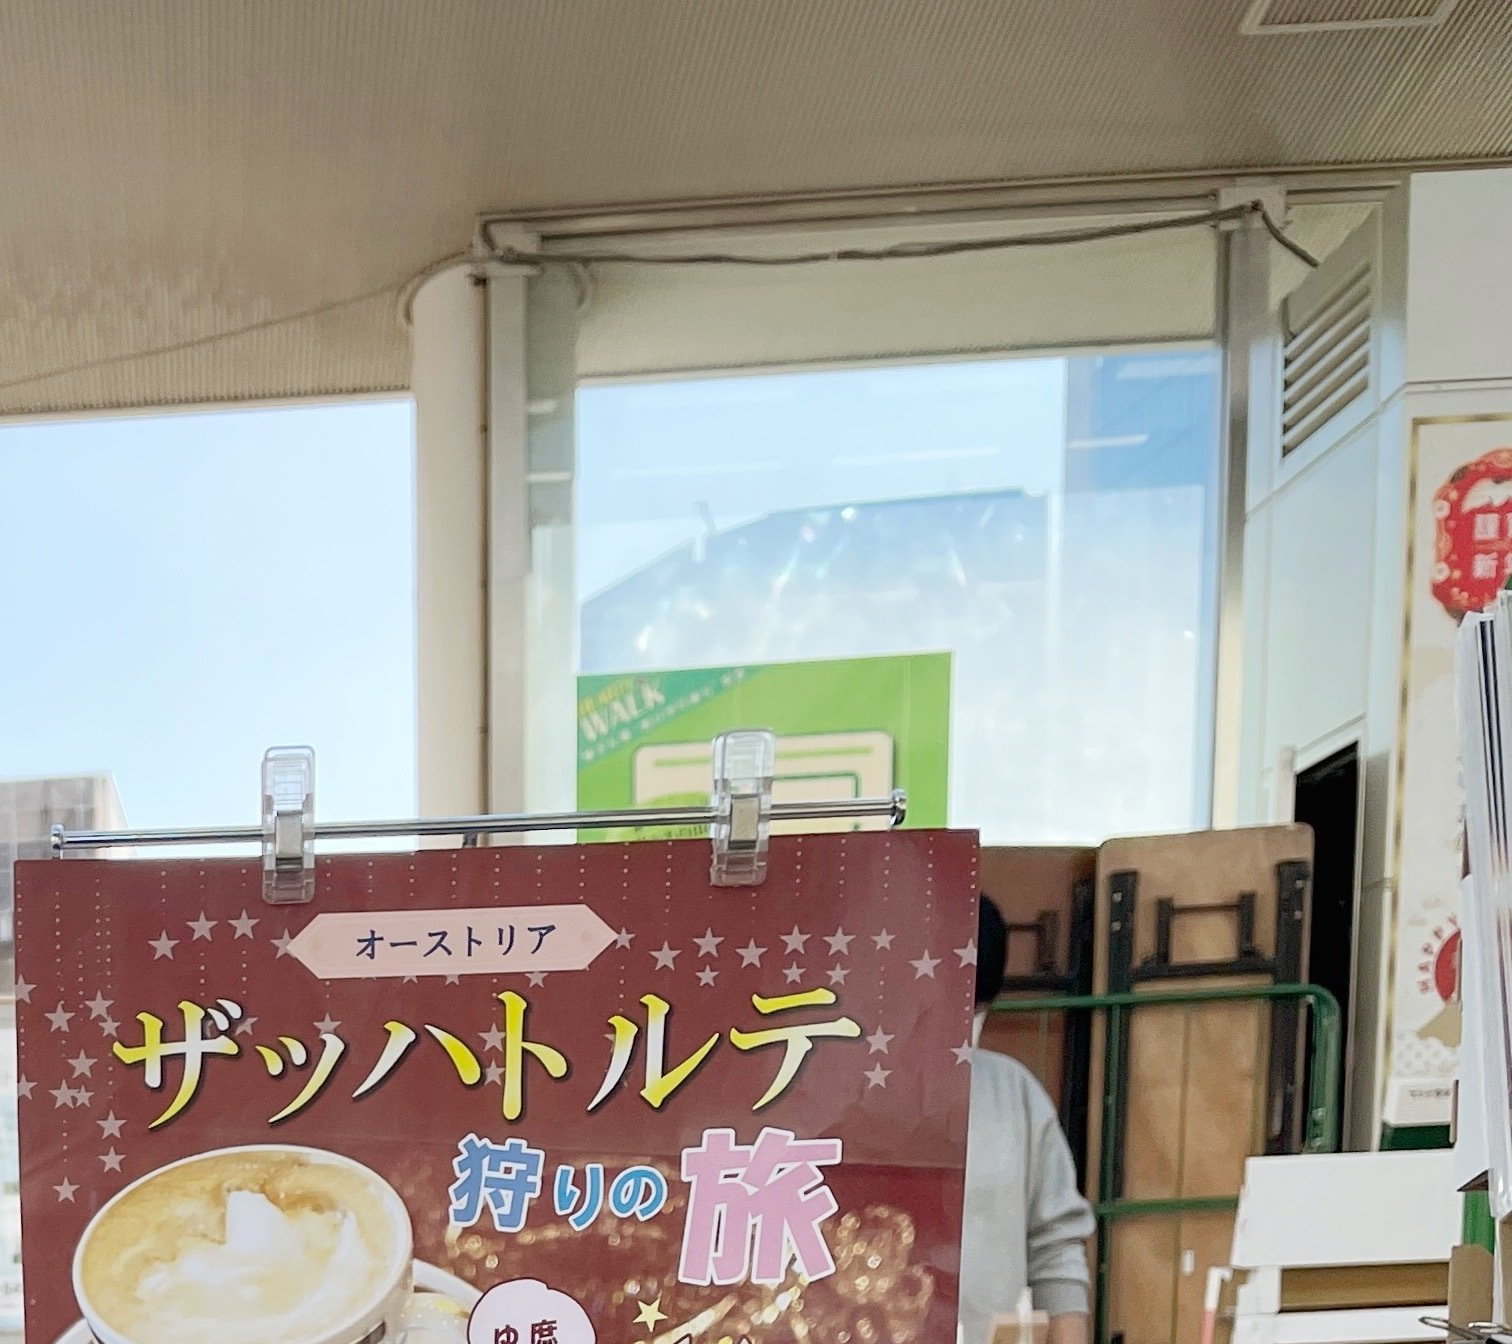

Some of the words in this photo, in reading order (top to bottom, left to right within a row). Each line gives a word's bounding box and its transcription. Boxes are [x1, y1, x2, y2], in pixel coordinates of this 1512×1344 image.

[582, 680, 666, 742] WALK
[354, 921, 557, 962] オーストリア
[111, 988, 863, 1130] ザッハトルテ
[449, 1126, 844, 1287] 狩りの旅
